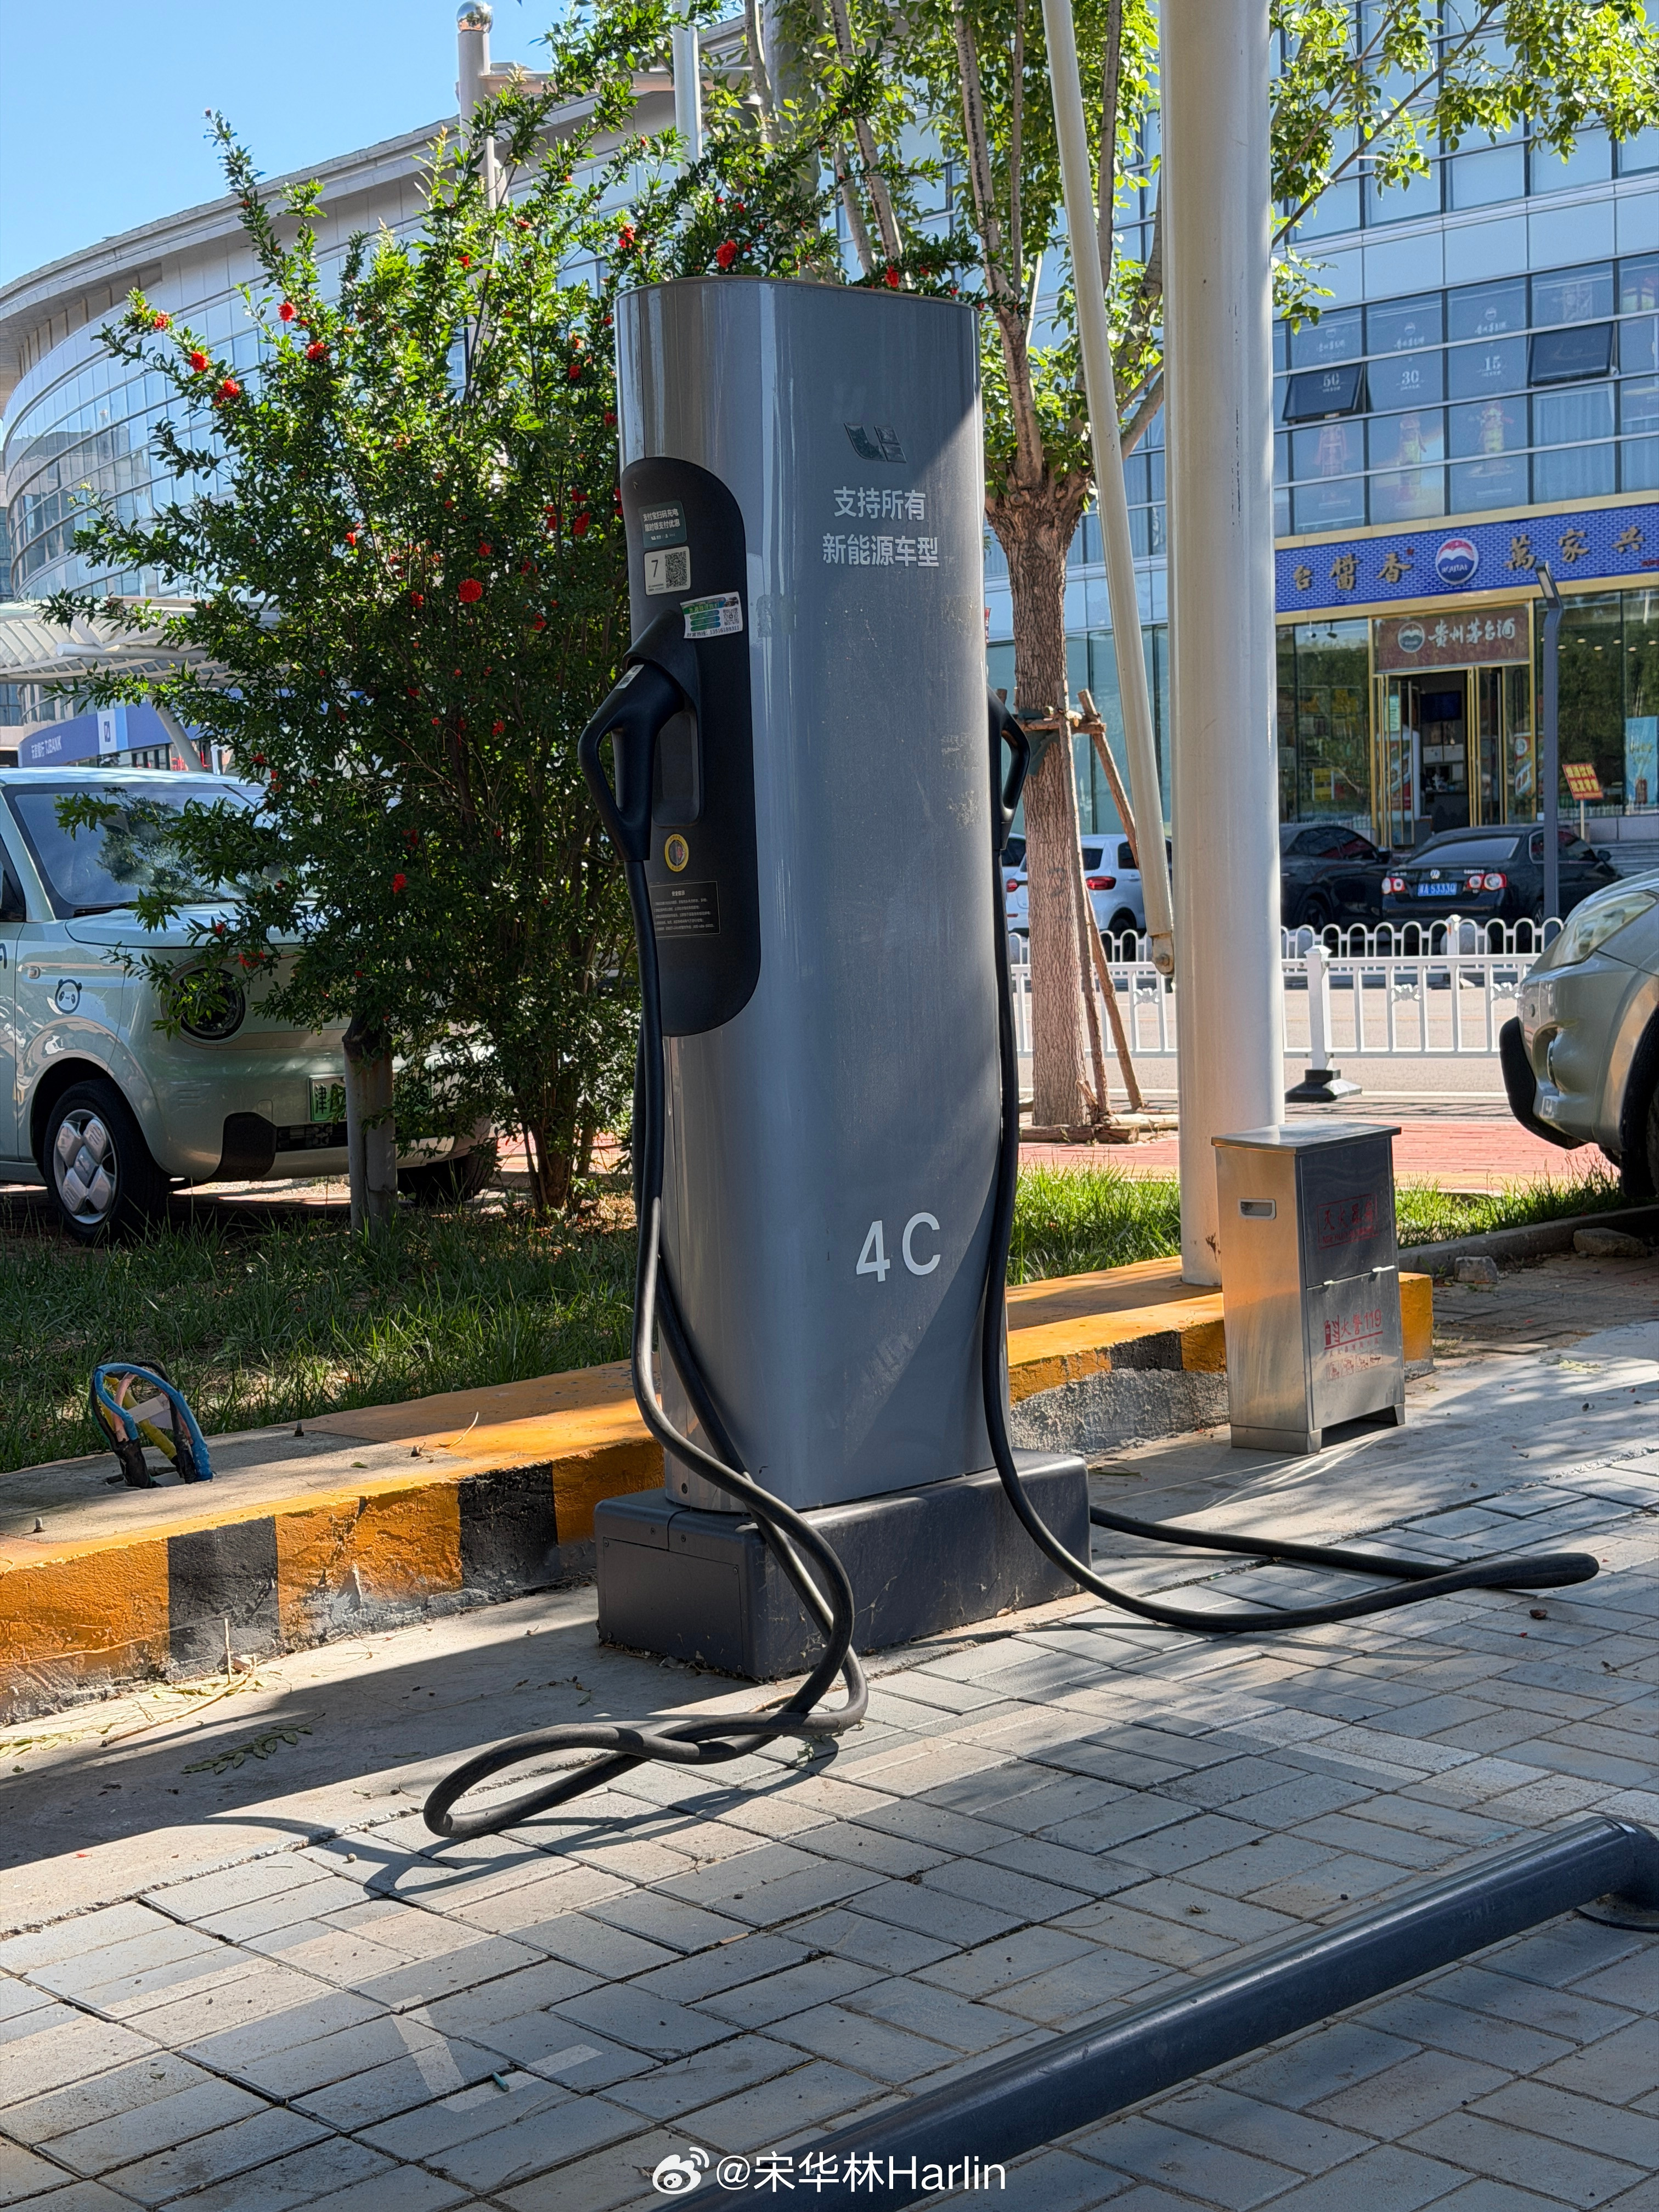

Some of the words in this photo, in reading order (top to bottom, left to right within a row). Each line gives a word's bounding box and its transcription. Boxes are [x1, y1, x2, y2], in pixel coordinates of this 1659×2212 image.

[1402, 370, 1419, 385] 30
[833, 486, 926, 521] 支持所有
[823, 533, 939, 567] 新能源车型
[651, 560, 658, 578] 7
[856, 1212, 941, 1282] 4C
